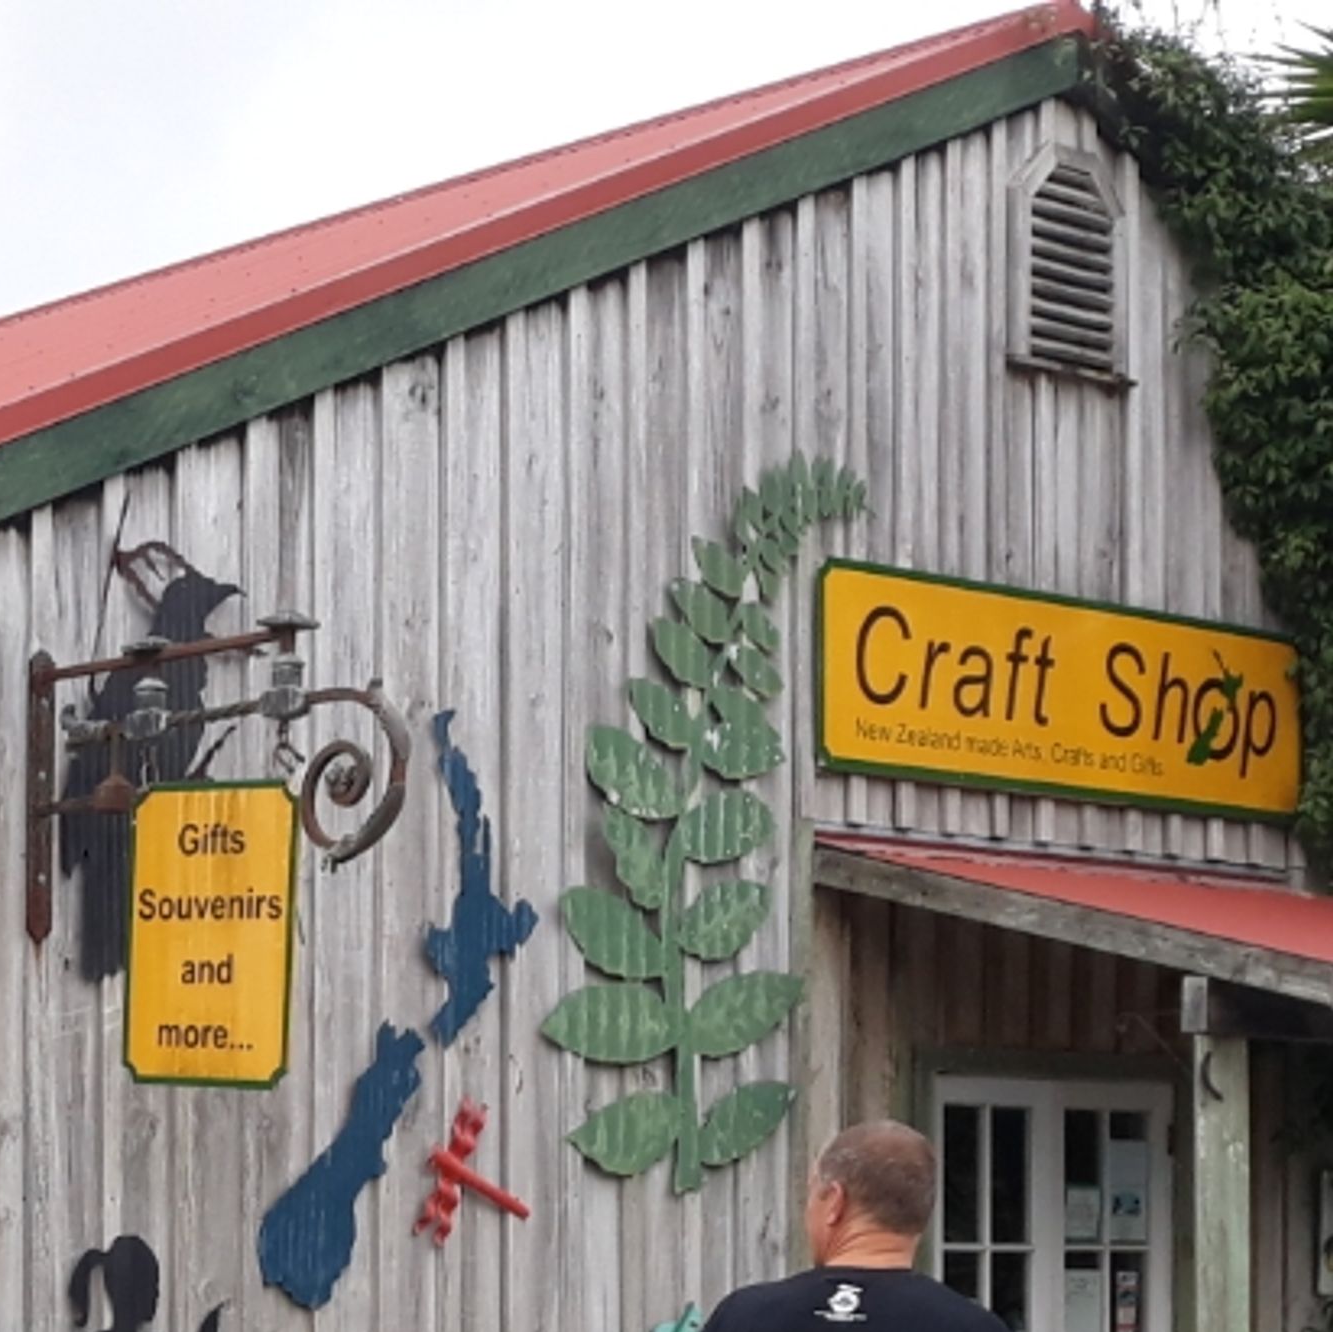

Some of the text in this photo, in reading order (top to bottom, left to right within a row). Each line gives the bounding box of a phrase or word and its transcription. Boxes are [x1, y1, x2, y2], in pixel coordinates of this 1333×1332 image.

[855, 605, 1277, 779] Craft Shop
[855, 716, 894, 743] New
[895, 722, 963, 753] Zealand
[964, 735, 1009, 757] made
[1050, 742, 1098, 767] Crafts
[1099, 750, 1130, 773] and
[1133, 754, 1166, 778] Gifts
[177, 823, 246, 855] Gifts
[138, 887, 284, 922] Souvenirs
[180, 953, 234, 985] and
[156, 1023, 254, 1051] more...
